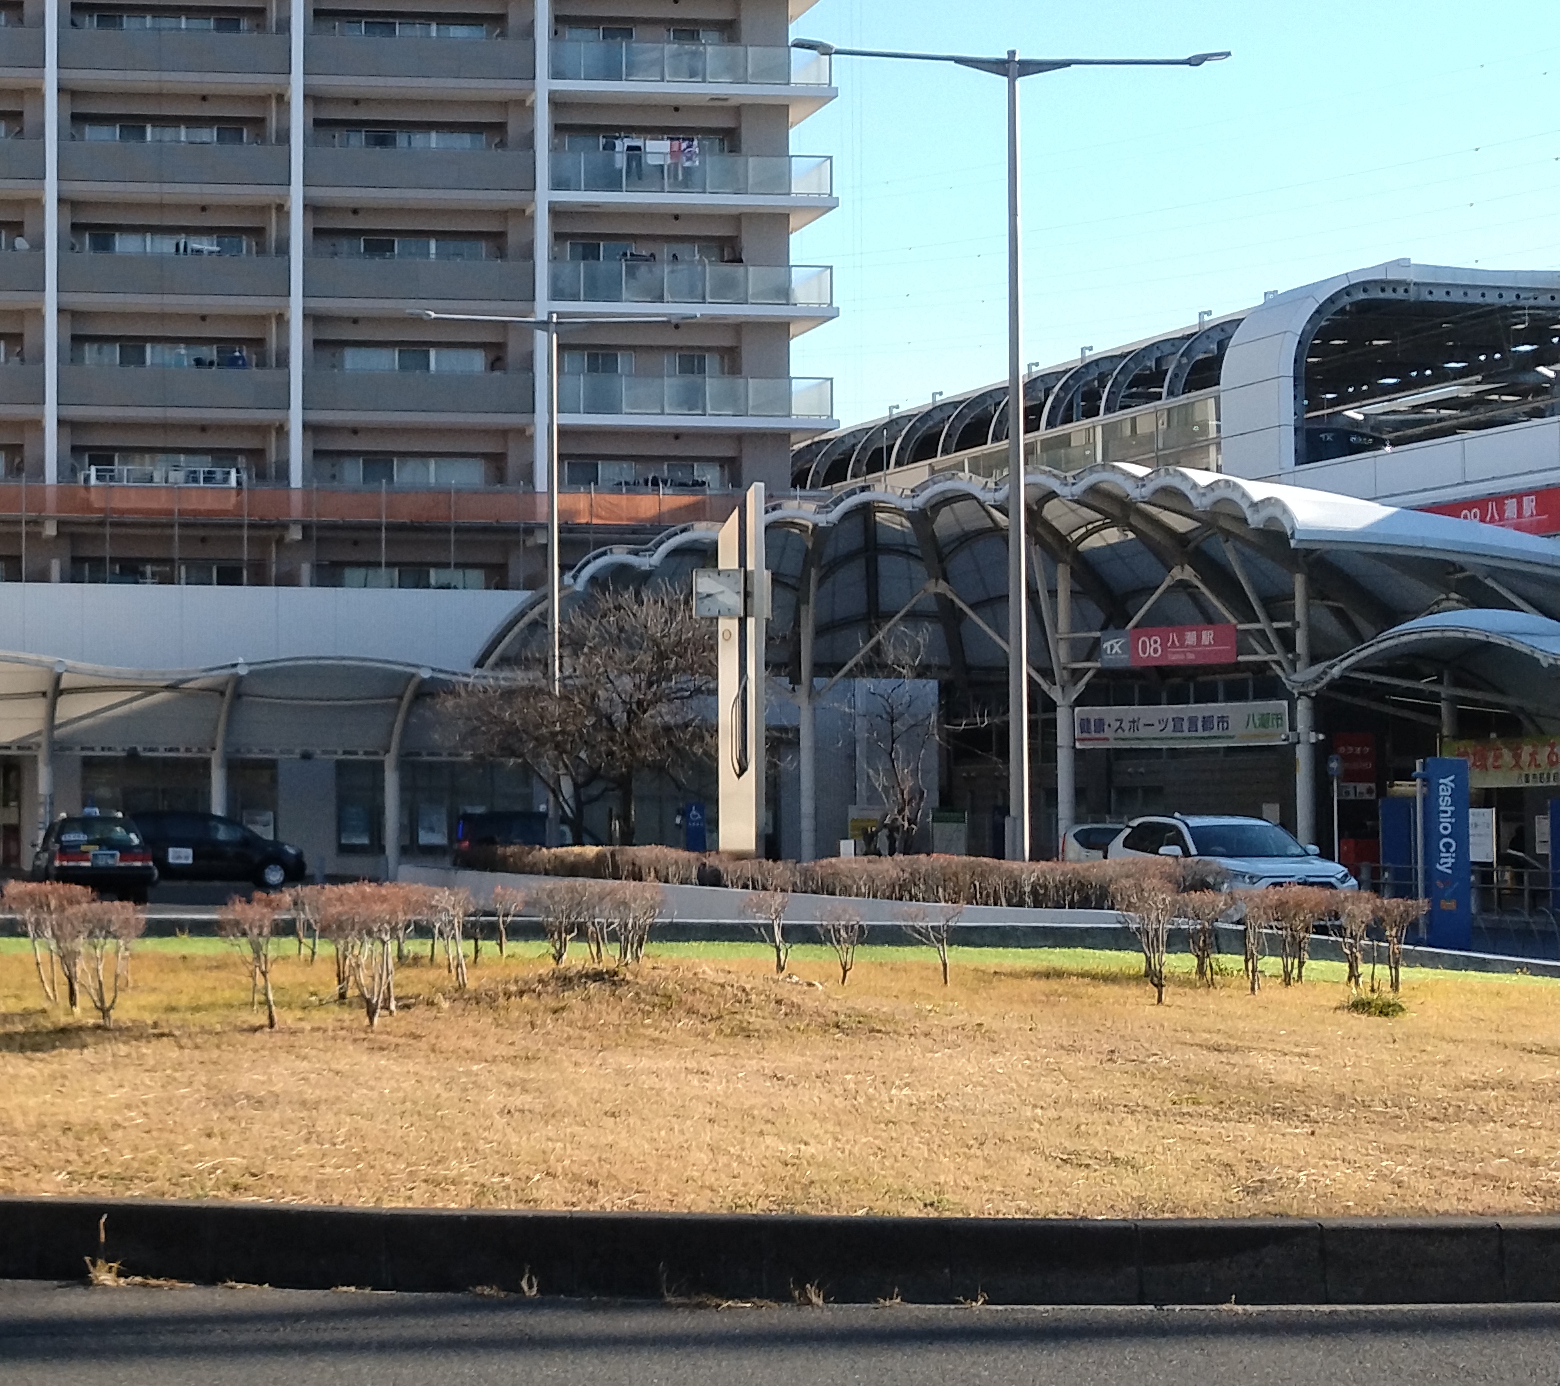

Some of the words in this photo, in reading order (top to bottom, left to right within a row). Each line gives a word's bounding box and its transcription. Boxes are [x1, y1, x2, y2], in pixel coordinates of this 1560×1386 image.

[1485, 495, 1536, 522] 八潮駅
[1103, 638, 1126, 655] TX
[1138, 636, 1162, 658] 08
[1167, 630, 1214, 647] 八潮駅
[1079, 715, 1230, 734] 健康・スポーツ宣言都市
[1245, 712, 1284, 730] 八潮市
[1439, 774, 1456, 835] Yashio
[1436, 837, 1457, 875] City
